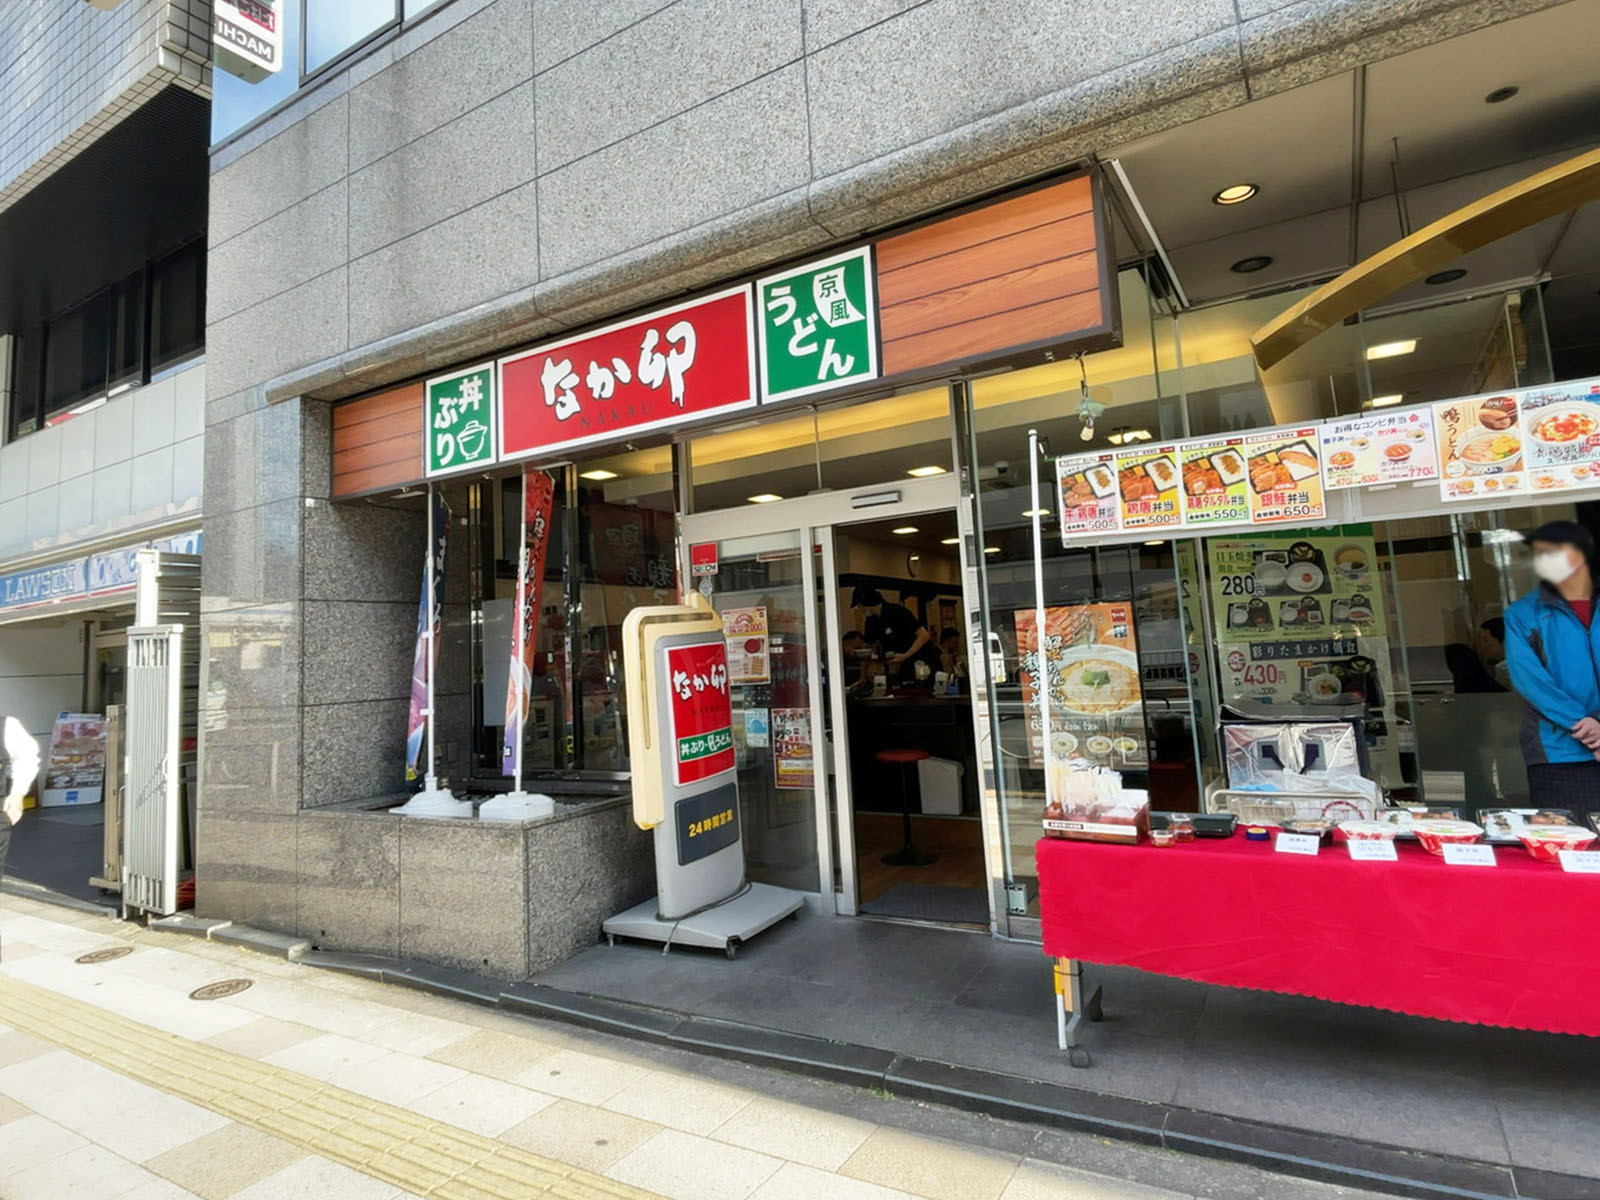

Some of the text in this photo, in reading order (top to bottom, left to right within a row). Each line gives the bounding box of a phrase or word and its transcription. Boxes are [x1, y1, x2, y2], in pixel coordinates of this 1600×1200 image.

[818, 271, 850, 323] 京風
[766, 285, 856, 382] うどん
[540, 320, 698, 422] なか卯
[4, 564, 77, 603] LAWSON
[672, 663, 728, 701] なか卯
